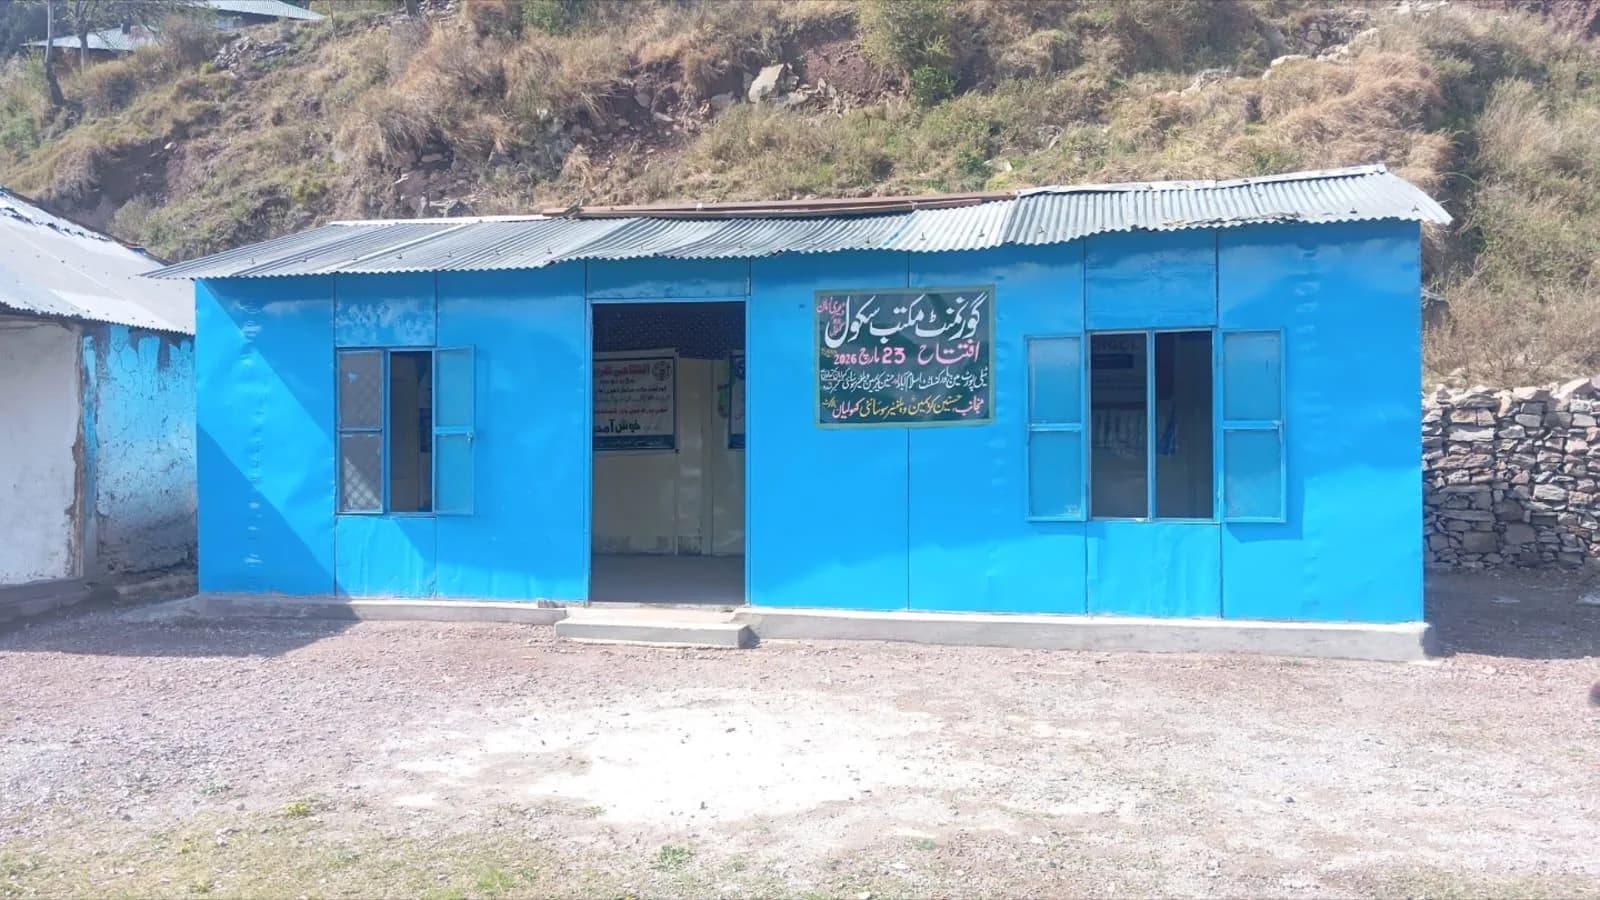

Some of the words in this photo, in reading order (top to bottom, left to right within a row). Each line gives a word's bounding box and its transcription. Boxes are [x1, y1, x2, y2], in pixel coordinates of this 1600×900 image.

[825, 295, 880, 348] سکول
[870, 294, 926, 344] مکتب
[915, 292, 988, 342] گورنمنٹ
[834, 352, 857, 366] 2026
[858, 347, 880, 365] مارچ
[882, 347, 906, 364] 23
[918, 341, 980, 365] افتتاح
[615, 418, 641, 434] خوش
